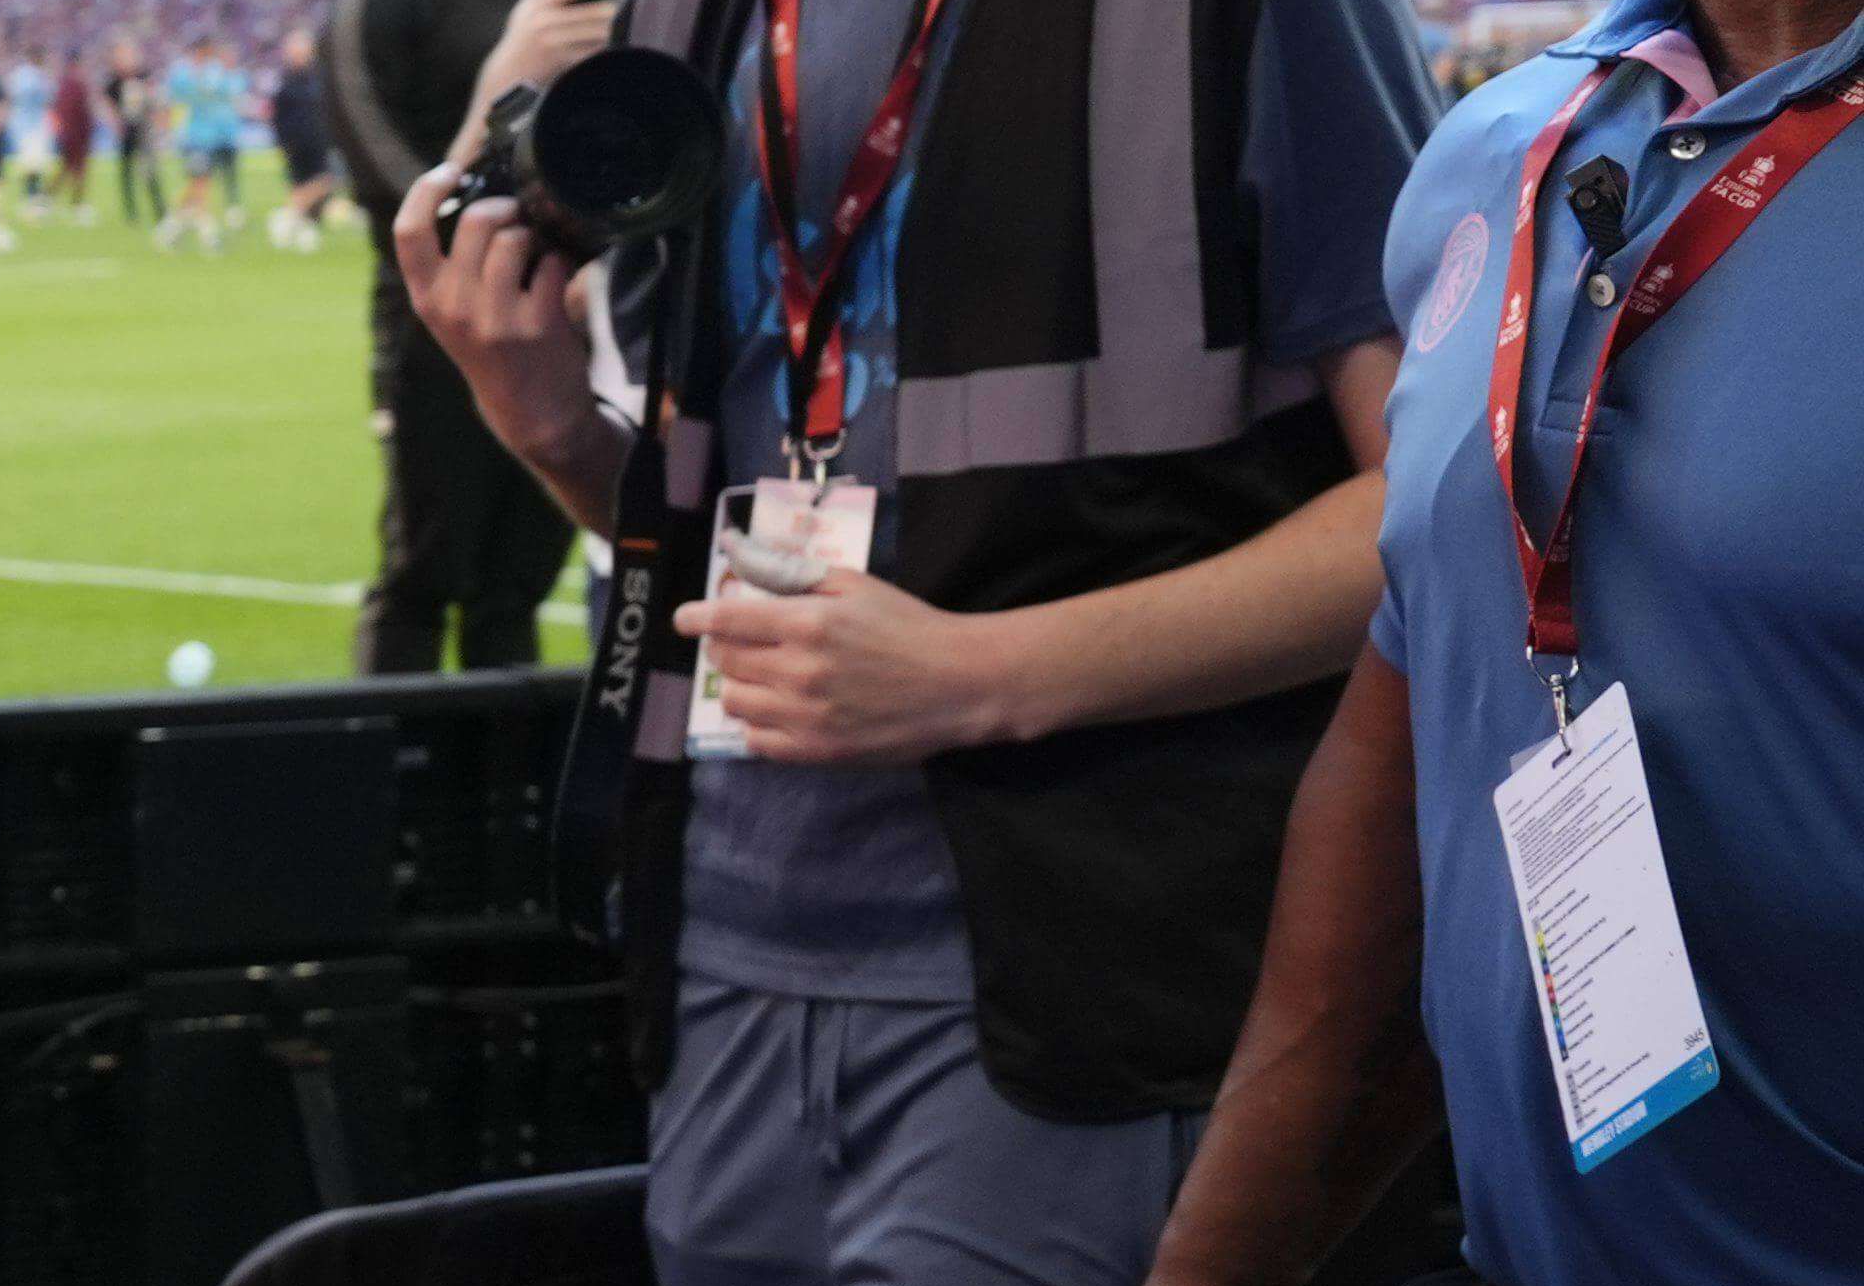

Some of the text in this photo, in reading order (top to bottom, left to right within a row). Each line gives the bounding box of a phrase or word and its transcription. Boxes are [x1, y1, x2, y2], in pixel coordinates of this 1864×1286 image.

[1710, 183, 1756, 208] FA CUP
[600, 568, 650, 716] SONY
